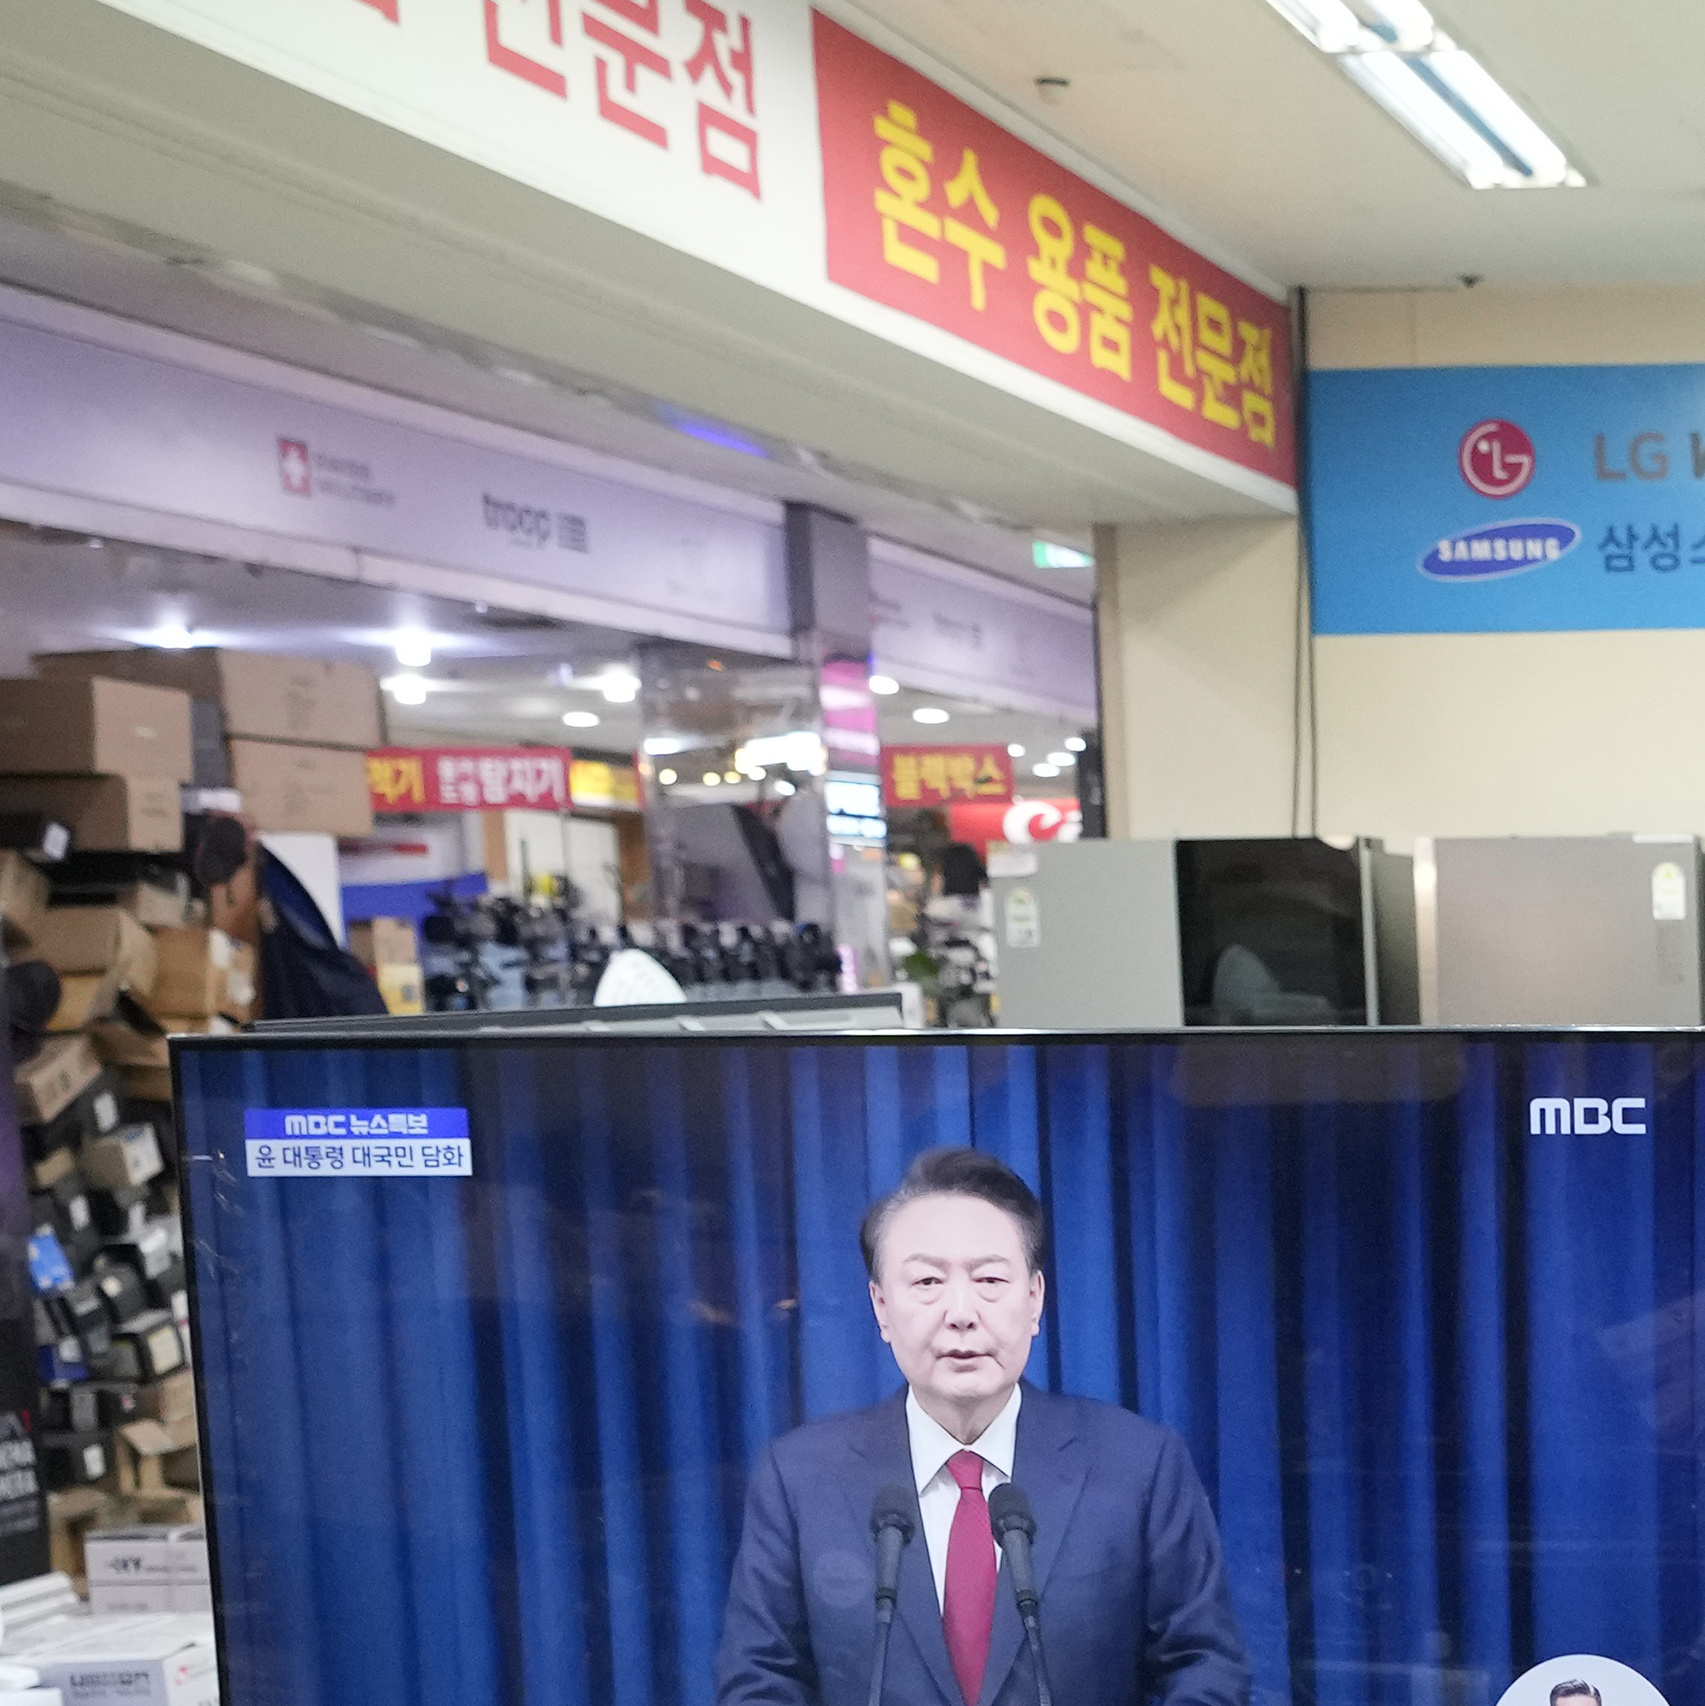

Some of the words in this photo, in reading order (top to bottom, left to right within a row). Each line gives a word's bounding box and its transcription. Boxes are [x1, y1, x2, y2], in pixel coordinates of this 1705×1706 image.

[873, 99, 1007, 312] 혼수
[1027, 193, 1133, 381] 용품
[1149, 264, 1276, 449] 전문점
[1593, 433, 1669, 482] LG
[1437, 536, 1561, 564] SAMSUNG
[285, 1115, 346, 1135] MBC
[350, 1114, 427, 1135] 뉴스특보
[1530, 1098, 1646, 1134] MBC
[255, 1145, 276, 1169] 윤
[282, 1145, 345, 1170] 대통령
[352, 1145, 414, 1169] 대국민
[422, 1145, 463, 1169] 담화
